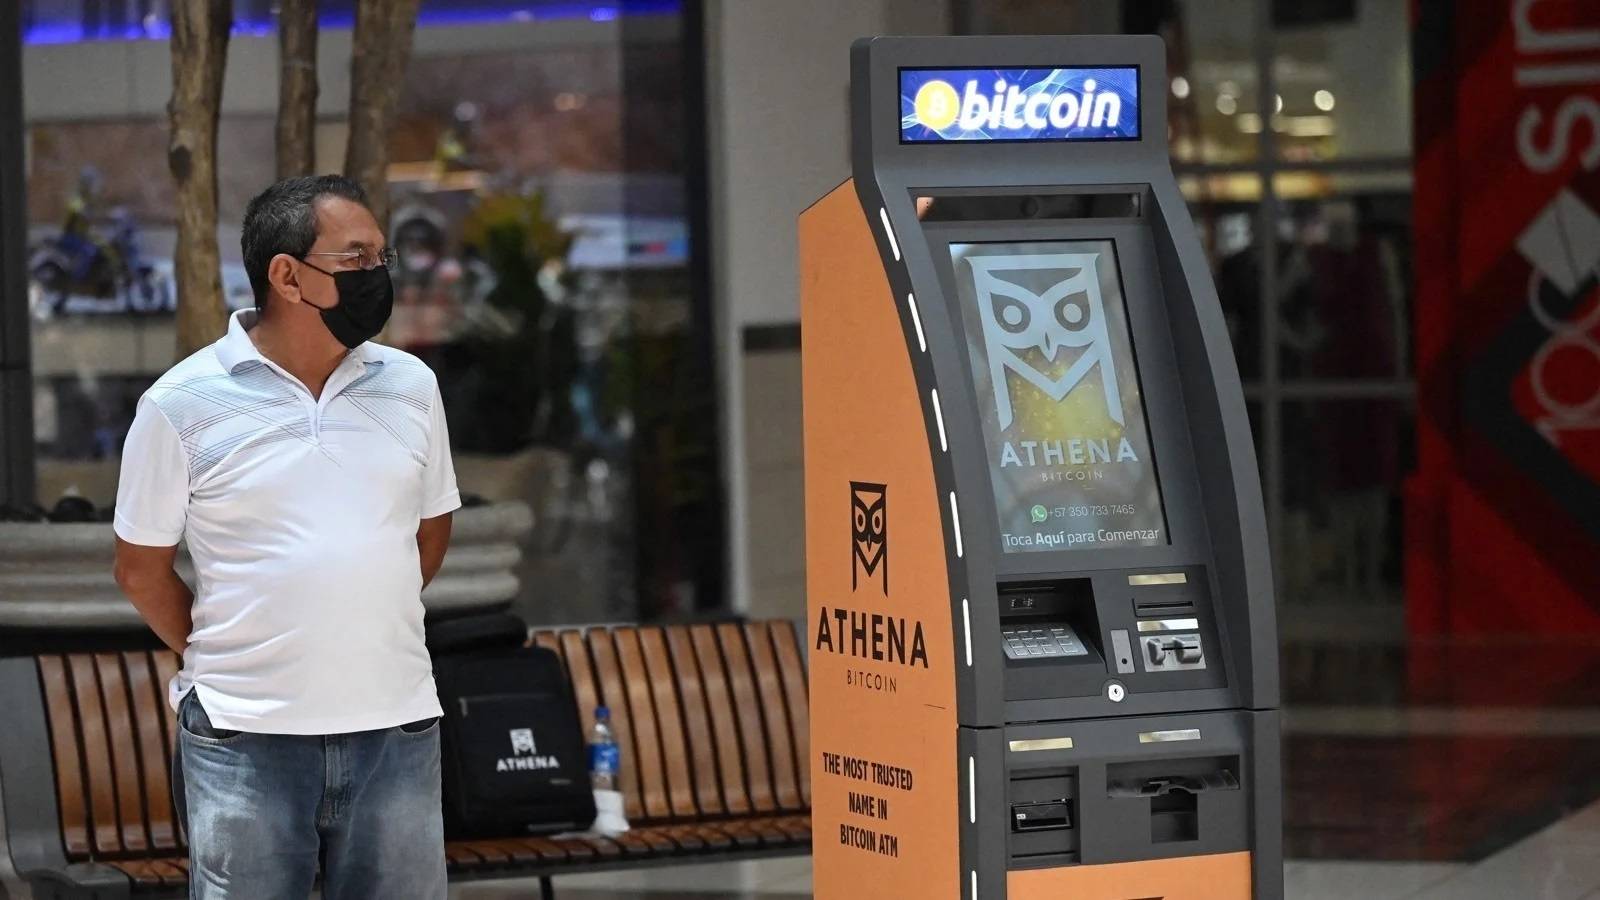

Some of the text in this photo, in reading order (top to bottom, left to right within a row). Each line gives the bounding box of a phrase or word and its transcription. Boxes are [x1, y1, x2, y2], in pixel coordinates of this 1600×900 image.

[959, 79, 1121, 130] bitcoin
[1001, 437, 1138, 468] ATHENA
[1041, 471, 1103, 481] BITCOIN
[1048, 504, 1135, 517] +57 350 733 7465
[1003, 529, 1160, 547] Toca Aquí para Comenzar
[816, 606, 929, 669] ATHENA
[847, 669, 897, 693] BITCOIN
[496, 756, 560, 772] ATHENA
[823, 752, 913, 791] THE MOST TRUSTED
[849, 792, 888, 820] NAME IN
[840, 824, 898, 858] BITCOIN ATM
